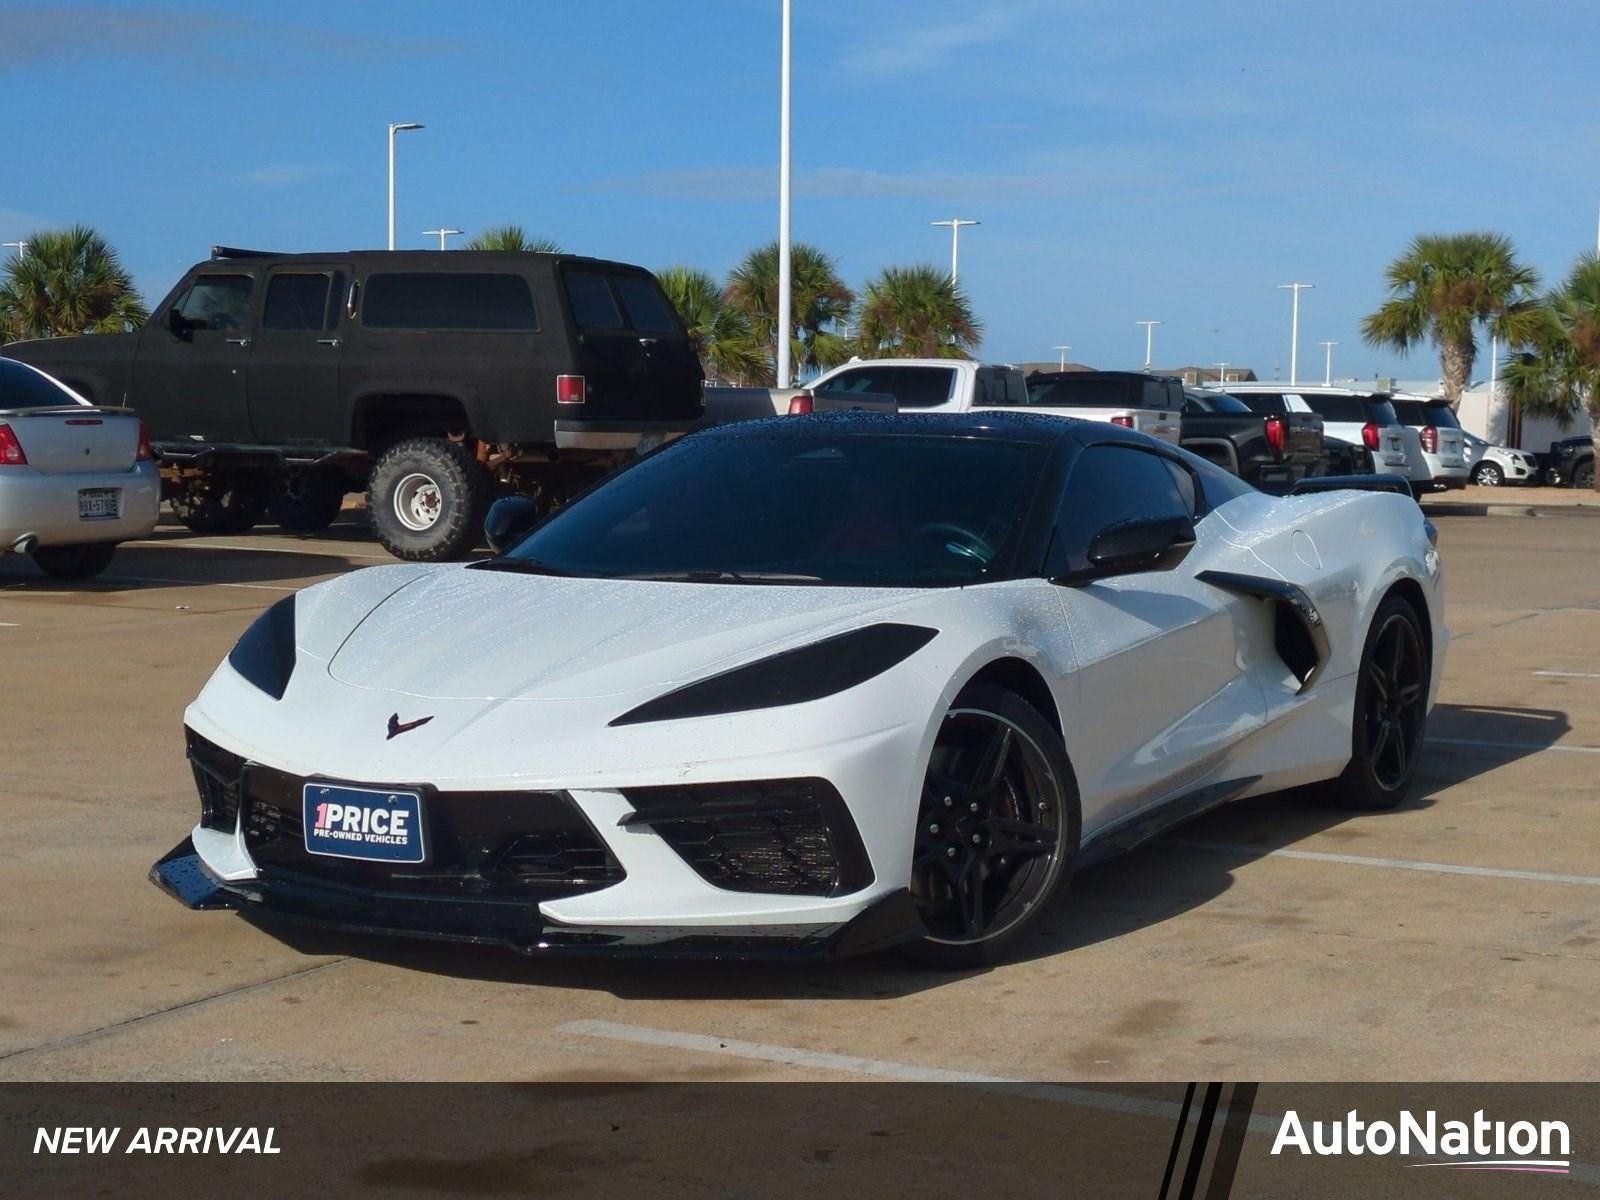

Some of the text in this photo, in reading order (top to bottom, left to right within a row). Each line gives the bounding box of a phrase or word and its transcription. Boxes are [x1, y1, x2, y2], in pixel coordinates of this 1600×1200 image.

[314, 803, 409, 836] 1PRICE
[313, 828, 408, 845] PRE-OWNED VEHICLES
